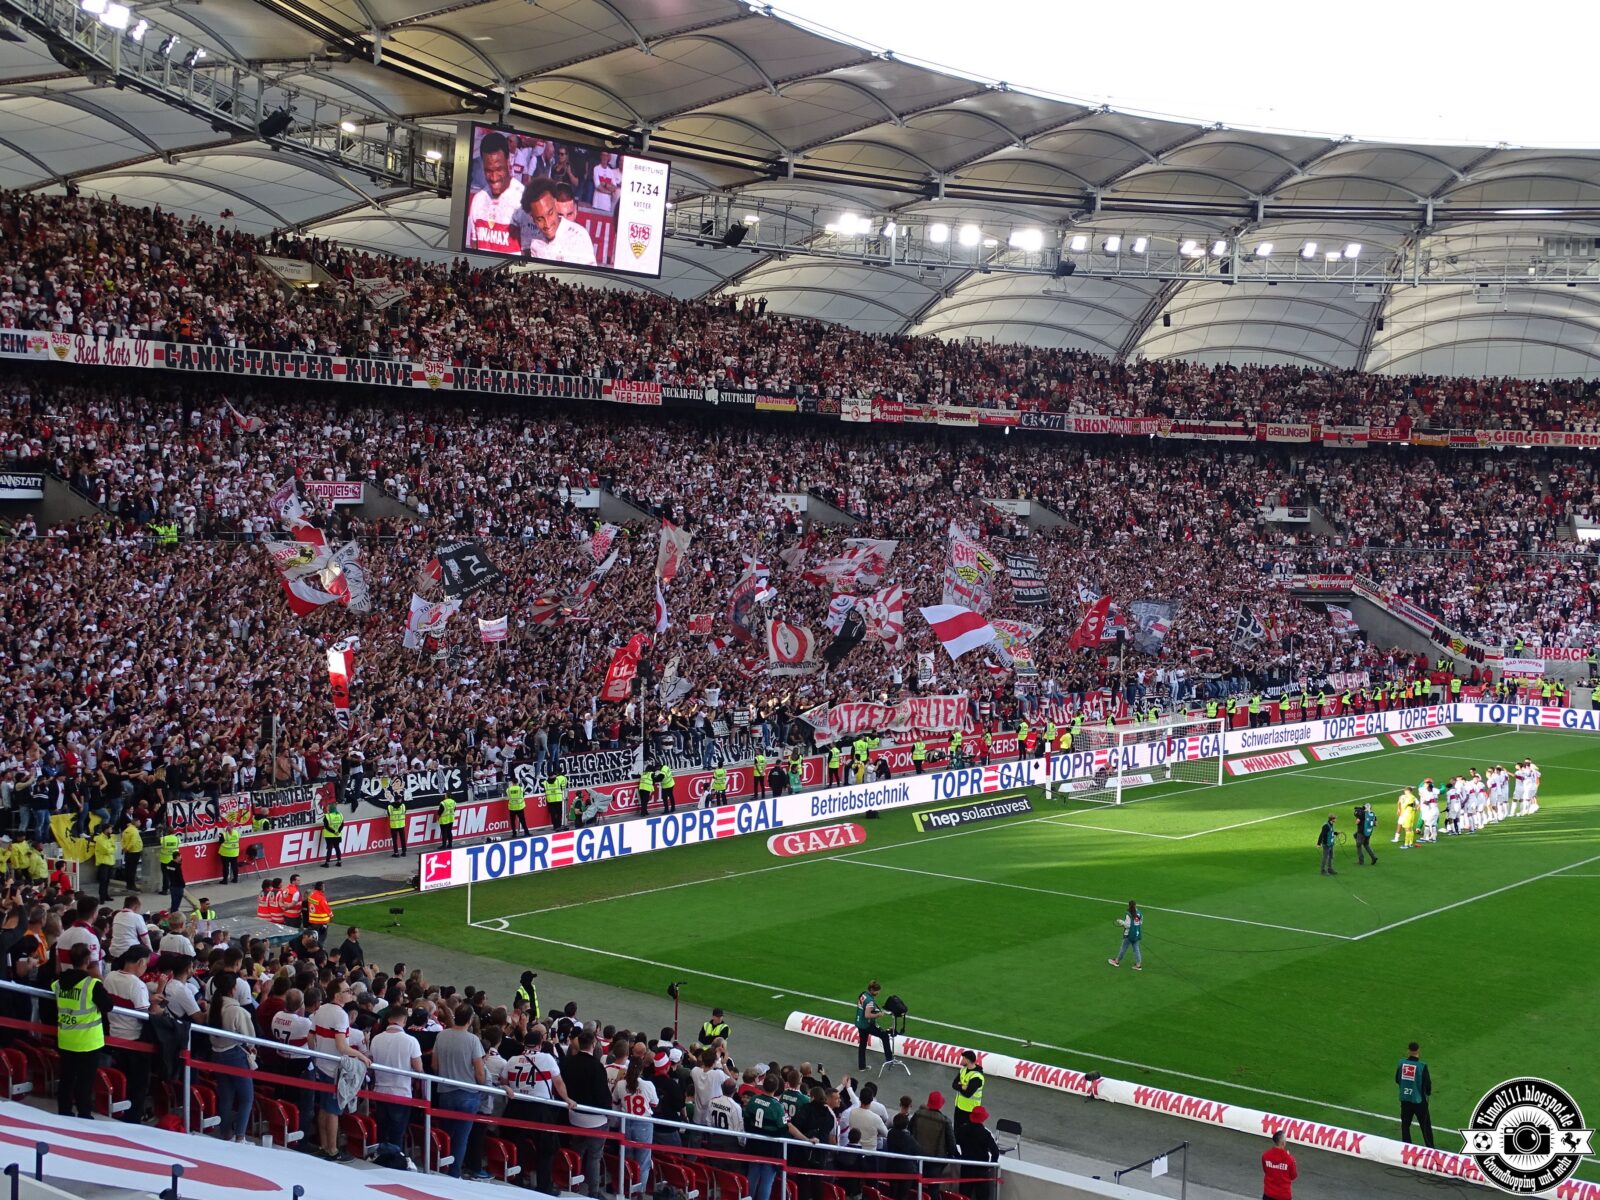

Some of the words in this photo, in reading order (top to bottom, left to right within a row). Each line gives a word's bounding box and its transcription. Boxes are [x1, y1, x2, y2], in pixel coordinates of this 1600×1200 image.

[634, 164, 664, 177] BREITLING
[630, 181, 659, 197] 17:34
[74, 335, 100, 364] Red
[102, 339, 131, 367] Hots
[134, 339, 149, 367] 96
[164, 343, 334, 380] CANNSTATTER
[346, 357, 413, 387] KURVE
[453, 367, 604, 400] NECKARSTADION
[612, 379, 662, 394] ALBSTADT
[614, 391, 661, 405] VFB-FANS
[720, 391, 756, 405] STUTTGART
[1049, 414, 1062, 428] 77
[1074, 416, 1110, 434] RHÖN
[1110, 419, 1133, 434] DONAU
[1267, 426, 1310, 438] GERLINGEN
[1493, 430, 1549, 445] GIENGEN
[317, 485, 349, 497] ADDICTS
[1518, 659, 1543, 668] WIMPFEN
[1534, 647, 1589, 661] URBACH
[1323, 714, 1389, 742] TOPREGAL
[1398, 703, 1463, 731] TOPREGAL
[1241, 725, 1311, 750] Schwerlastregale
[1413, 729, 1443, 743] WÜRTH
[1241, 751, 1297, 774] WINAMAX
[931, 762, 1036, 801] TOPREGAL
[810, 783, 910, 818] Betriebstechnik
[172, 800, 216, 829] DKS
[646, 799, 783, 844] TOPREGAL
[930, 811, 960, 828] hep
[962, 798, 1031, 821] solarinvest
[194, 845, 207, 858] 32
[466, 824, 632, 882] TOPREGAL
[424, 881, 452, 890] BUNDESLIGA
[514, 1065, 537, 1090] 74
[1014, 1060, 1104, 1097] WINAMAX
[624, 1093, 646, 1117] 18
[1133, 1085, 1229, 1124] WINAMAX
[711, 1109, 730, 1130] 10
[755, 1107, 765, 1129] 9
[1261, 1113, 1366, 1155] WINAMAX
